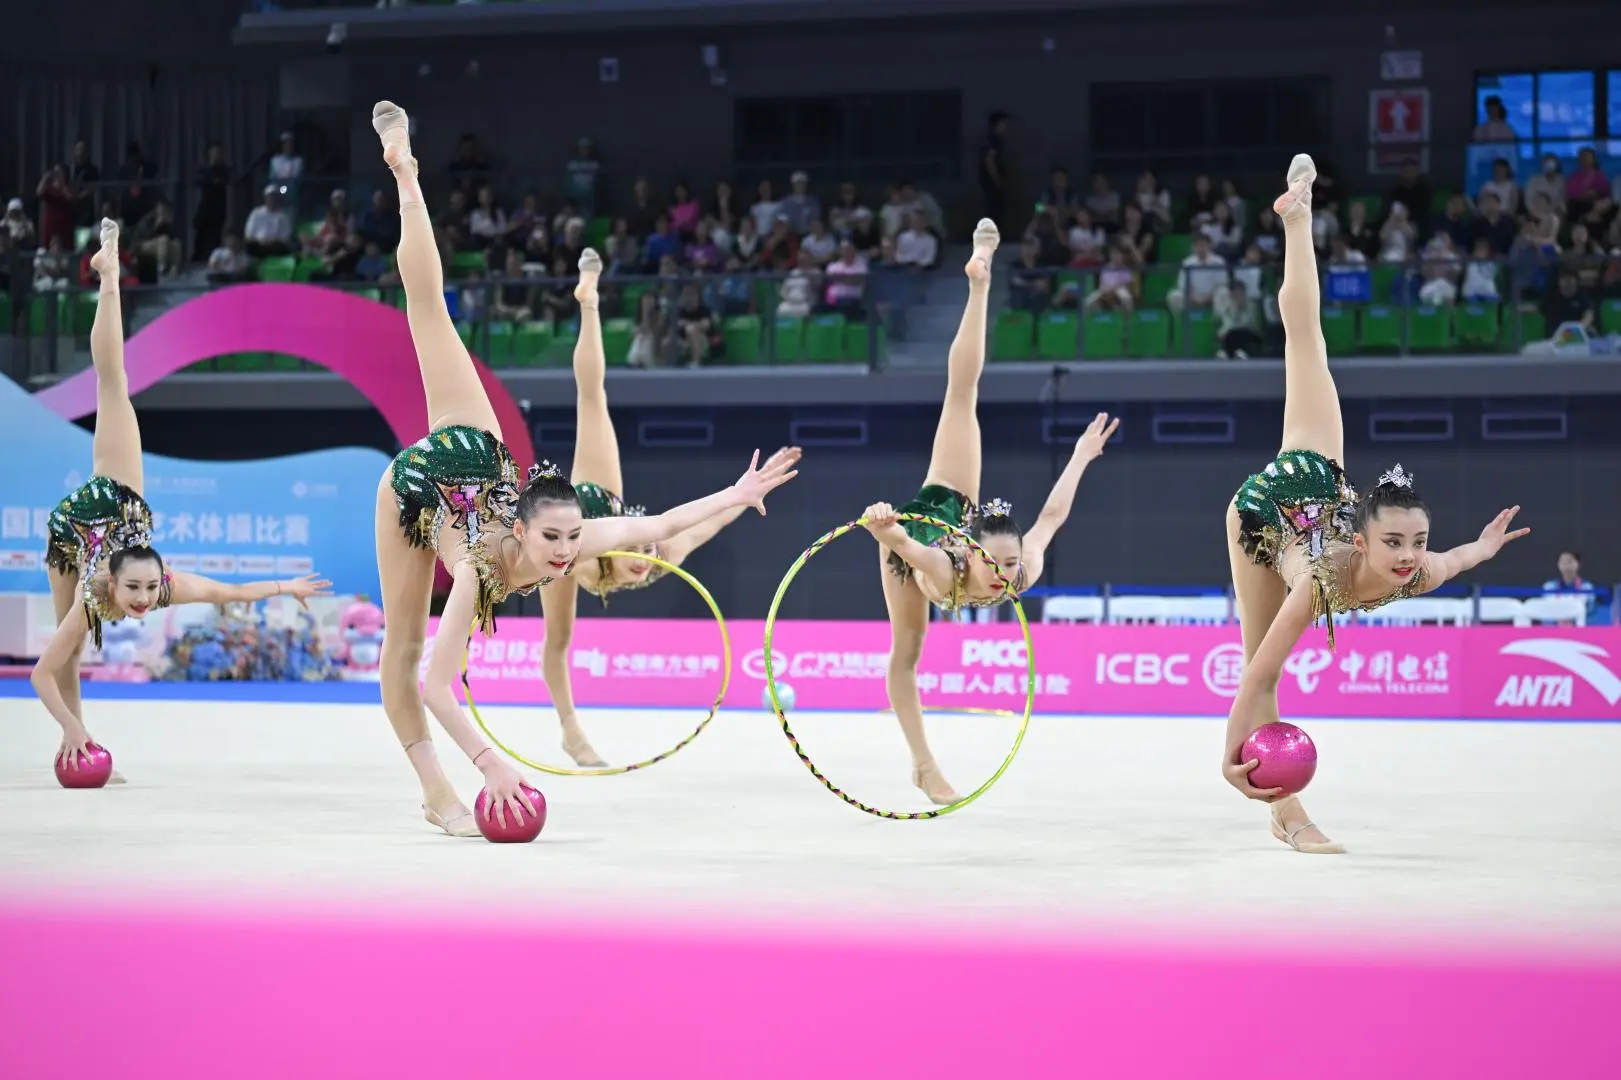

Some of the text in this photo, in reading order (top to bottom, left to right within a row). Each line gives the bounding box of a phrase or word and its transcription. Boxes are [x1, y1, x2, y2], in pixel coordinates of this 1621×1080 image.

[962, 639, 1029, 667] PICC
[1340, 650, 1448, 683] 中国电信
[916, 673, 1071, 695] 中国人民保险
[1096, 653, 1190, 685] ICBC
[1339, 682, 1449, 693] CHINA TELECOM
[1495, 675, 1574, 707] ANTA
